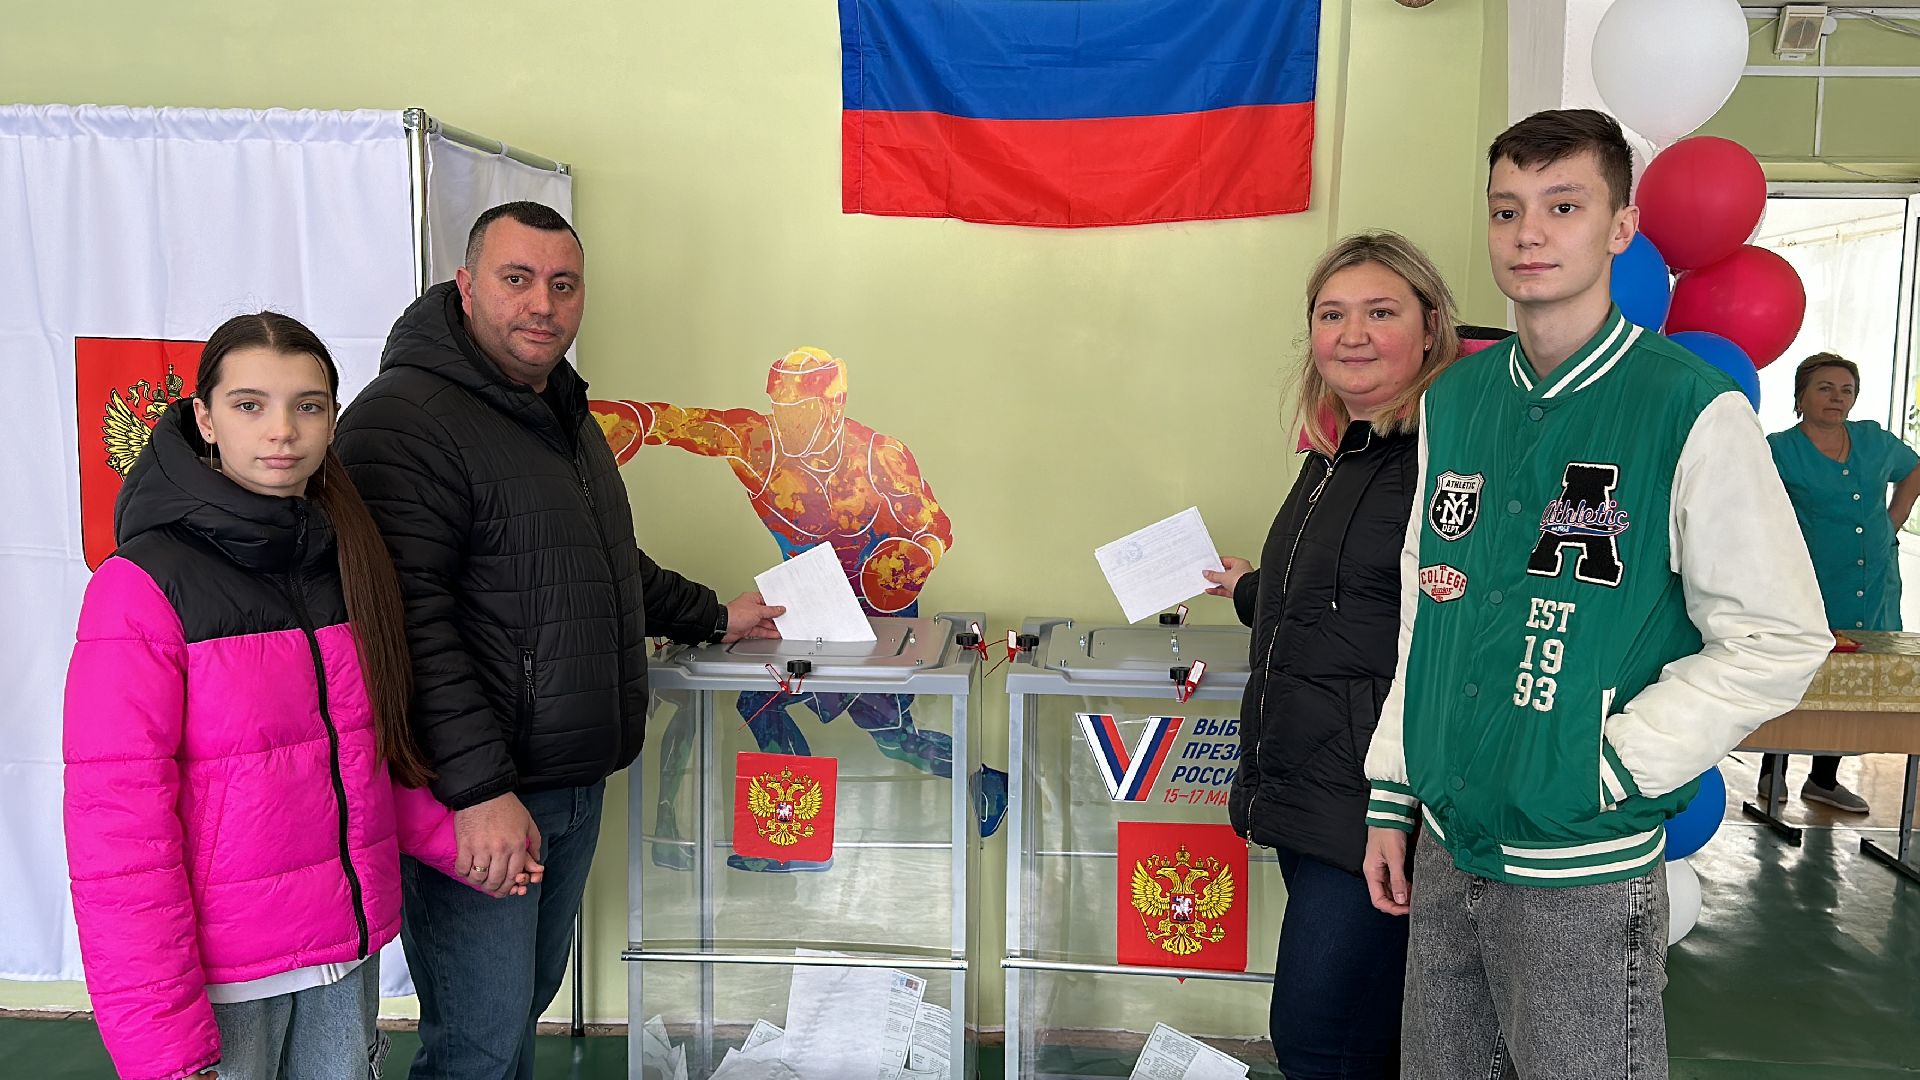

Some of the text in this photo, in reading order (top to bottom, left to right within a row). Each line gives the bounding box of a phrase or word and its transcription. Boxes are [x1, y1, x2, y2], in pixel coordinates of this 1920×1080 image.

[1445, 480, 1476, 490] ATHLETIC
[1540, 498, 1630, 527] Athletic
[1441, 524, 1460, 534] DEPT.
[1420, 569, 1466, 592] COLLEGE
[1525, 597, 1576, 633] EST
[1519, 635, 1565, 675] 19
[1512, 672, 1557, 712] 93
[1192, 718, 1240, 737] ВЫБ
[1204, 790, 1229, 806] МА
